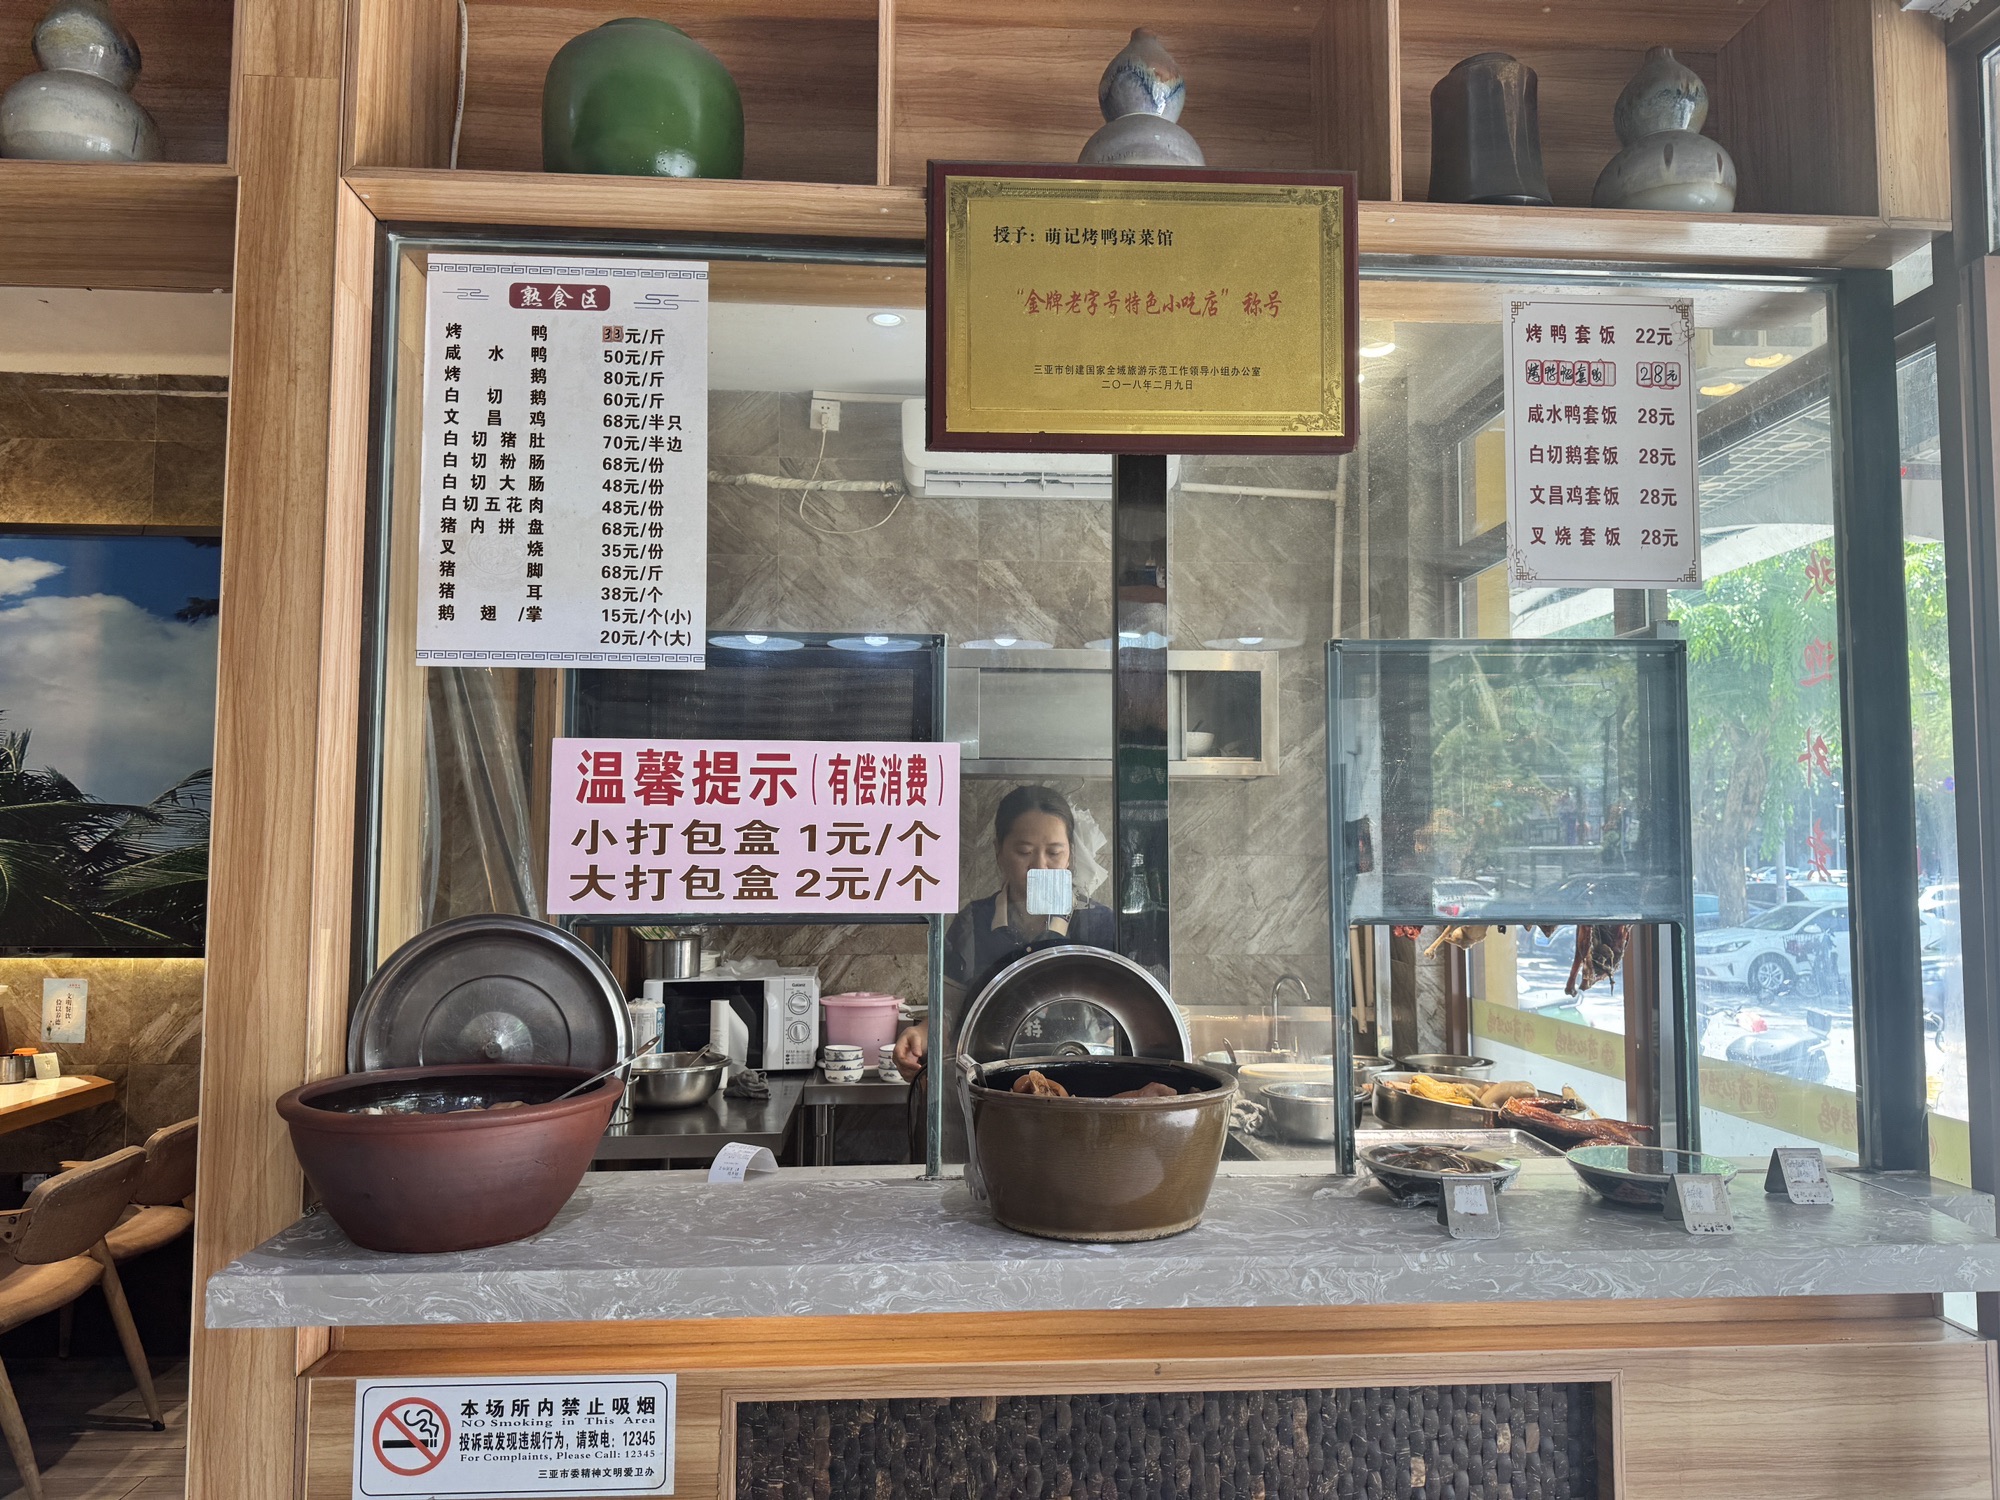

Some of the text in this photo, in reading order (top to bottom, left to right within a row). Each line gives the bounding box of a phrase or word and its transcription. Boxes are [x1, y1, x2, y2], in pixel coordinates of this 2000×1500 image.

[520, 286, 598, 307] 熟食区
[446, 323, 547, 341] 烤鸭
[1526, 324, 1672, 345] 烤鸭套饭 22元
[445, 344, 665, 366] 咸水鸭 50元/斤
[445, 366, 664, 387] 烤鹅 80元/斤
[1034, 365, 1261, 377] 三亚市创建国家全域旅游示范工作领导小组办公室
[1640, 366, 1678, 382] 28元
[446, 387, 664, 409] 白切鹅 60元/斤
[444, 409, 682, 430] 文昌鸡 68元/半只
[1528, 404, 1675, 425] 咸水鸭套饭 28元
[444, 430, 682, 452] 白切猪肚 70元/半边
[444, 452, 664, 473] 白切粉肠 68元/份
[1530, 445, 1676, 466] 白切鹅套饭 28元
[443, 474, 664, 494] 白切大肠 48元/份
[443, 495, 664, 516] 白切五花肉 48元/份
[1530, 485, 1677, 506] 文昌鸡套饭 28元
[441, 517, 663, 538] 猪内拼盘 68元/份
[1531, 526, 1678, 547] 叉烧套饭 28元
[440, 540, 663, 559] 叉烧 35元/份
[440, 560, 663, 581] 猪脚 68元/斤
[439, 582, 662, 603] 猪耳 38元/个
[438, 605, 691, 625] 鹅翅/掌 15元/个(小)
[601, 630, 691, 646] 20元/个(大)
[576, 749, 944, 806] 温馨提示（有偿消费）
[571, 819, 940, 856] 小打包盒 1元/个
[570, 865, 940, 901] 大打包盒 2元/个
[461, 1397, 655, 1418] 本场所内禁止吸烟
[490, 1418, 553, 1429] Smoking
[483, 1452, 553, 1462] Complaints,
[557, 1451, 590, 1460] Please
[625, 1450, 655, 1458] 12345
[539, 1467, 654, 1479] 三亚市委精神文明爱卫办
